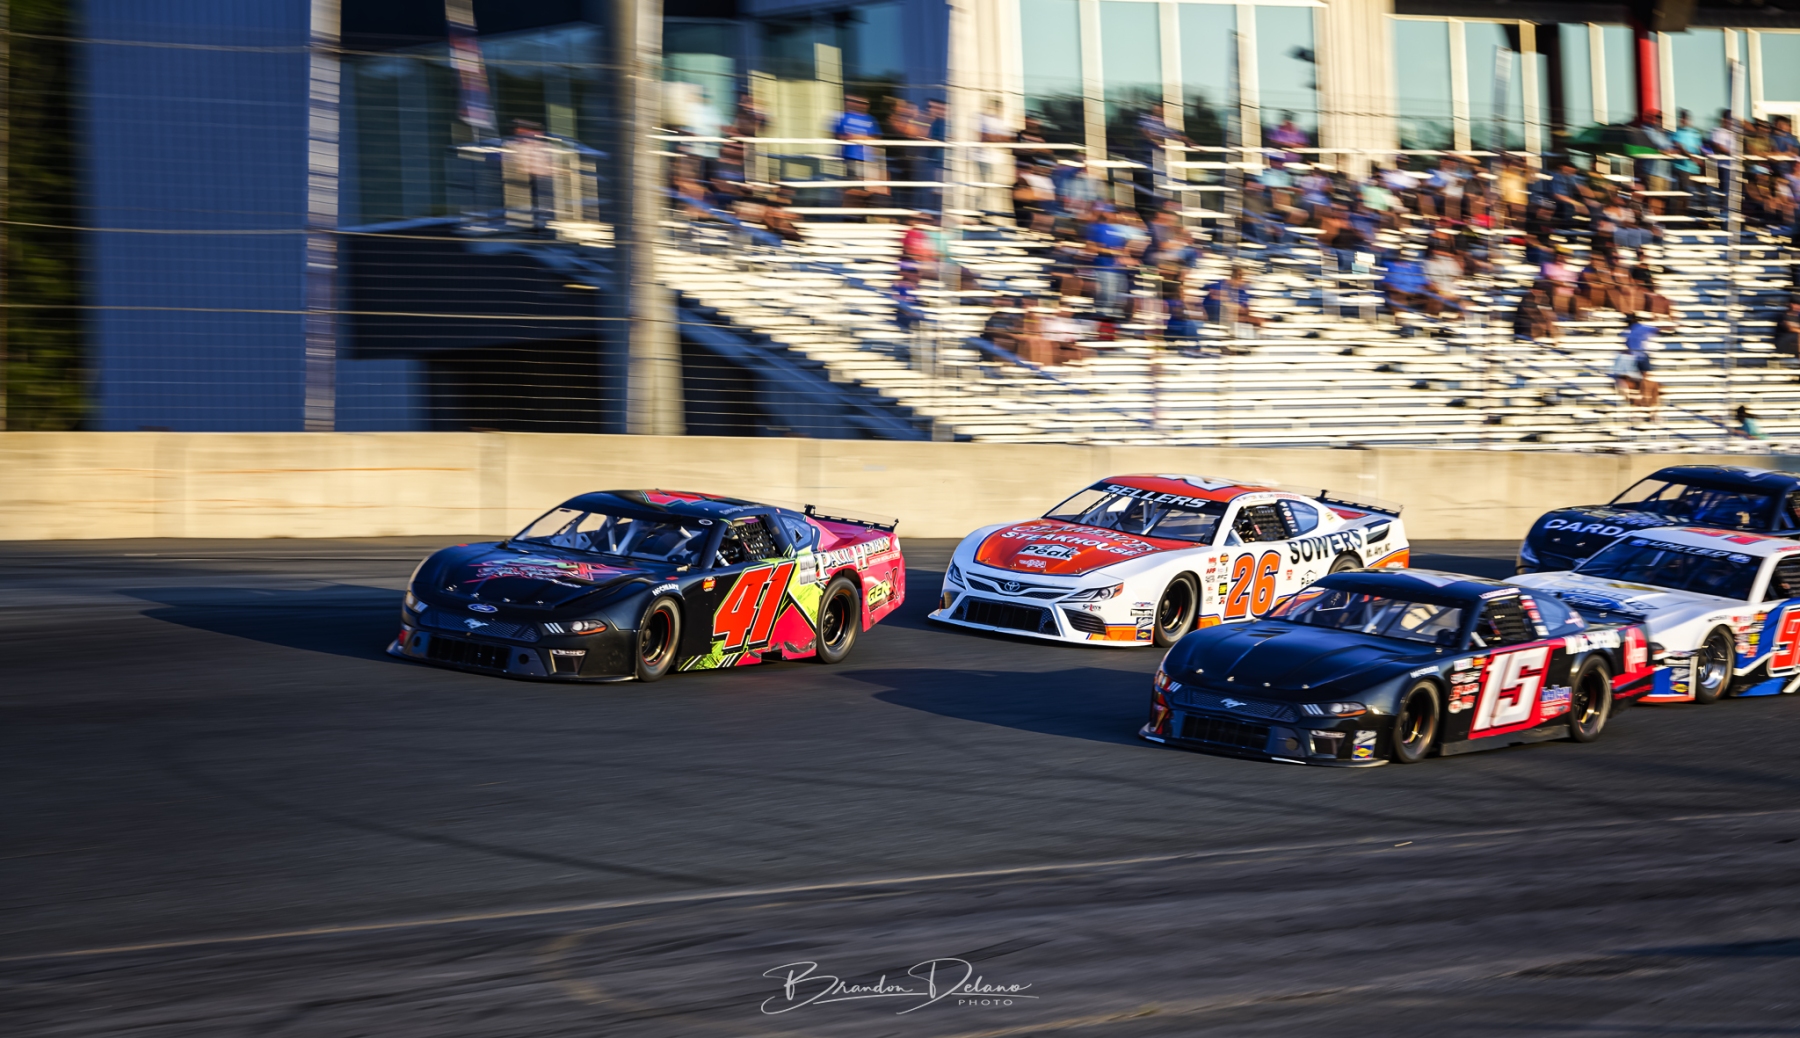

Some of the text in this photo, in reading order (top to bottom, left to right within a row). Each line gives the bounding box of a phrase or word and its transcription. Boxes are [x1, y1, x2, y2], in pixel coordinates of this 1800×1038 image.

[1103, 484, 1212, 508] SELLERS
[1000, 531, 1139, 557] STEAKHOUSE
[1022, 545, 1072, 561] Peak
[1286, 529, 1362, 565] SOWERS
[1224, 549, 1281, 619] 26
[712, 560, 796, 651] 41
[1472, 646, 1550, 731] 15
